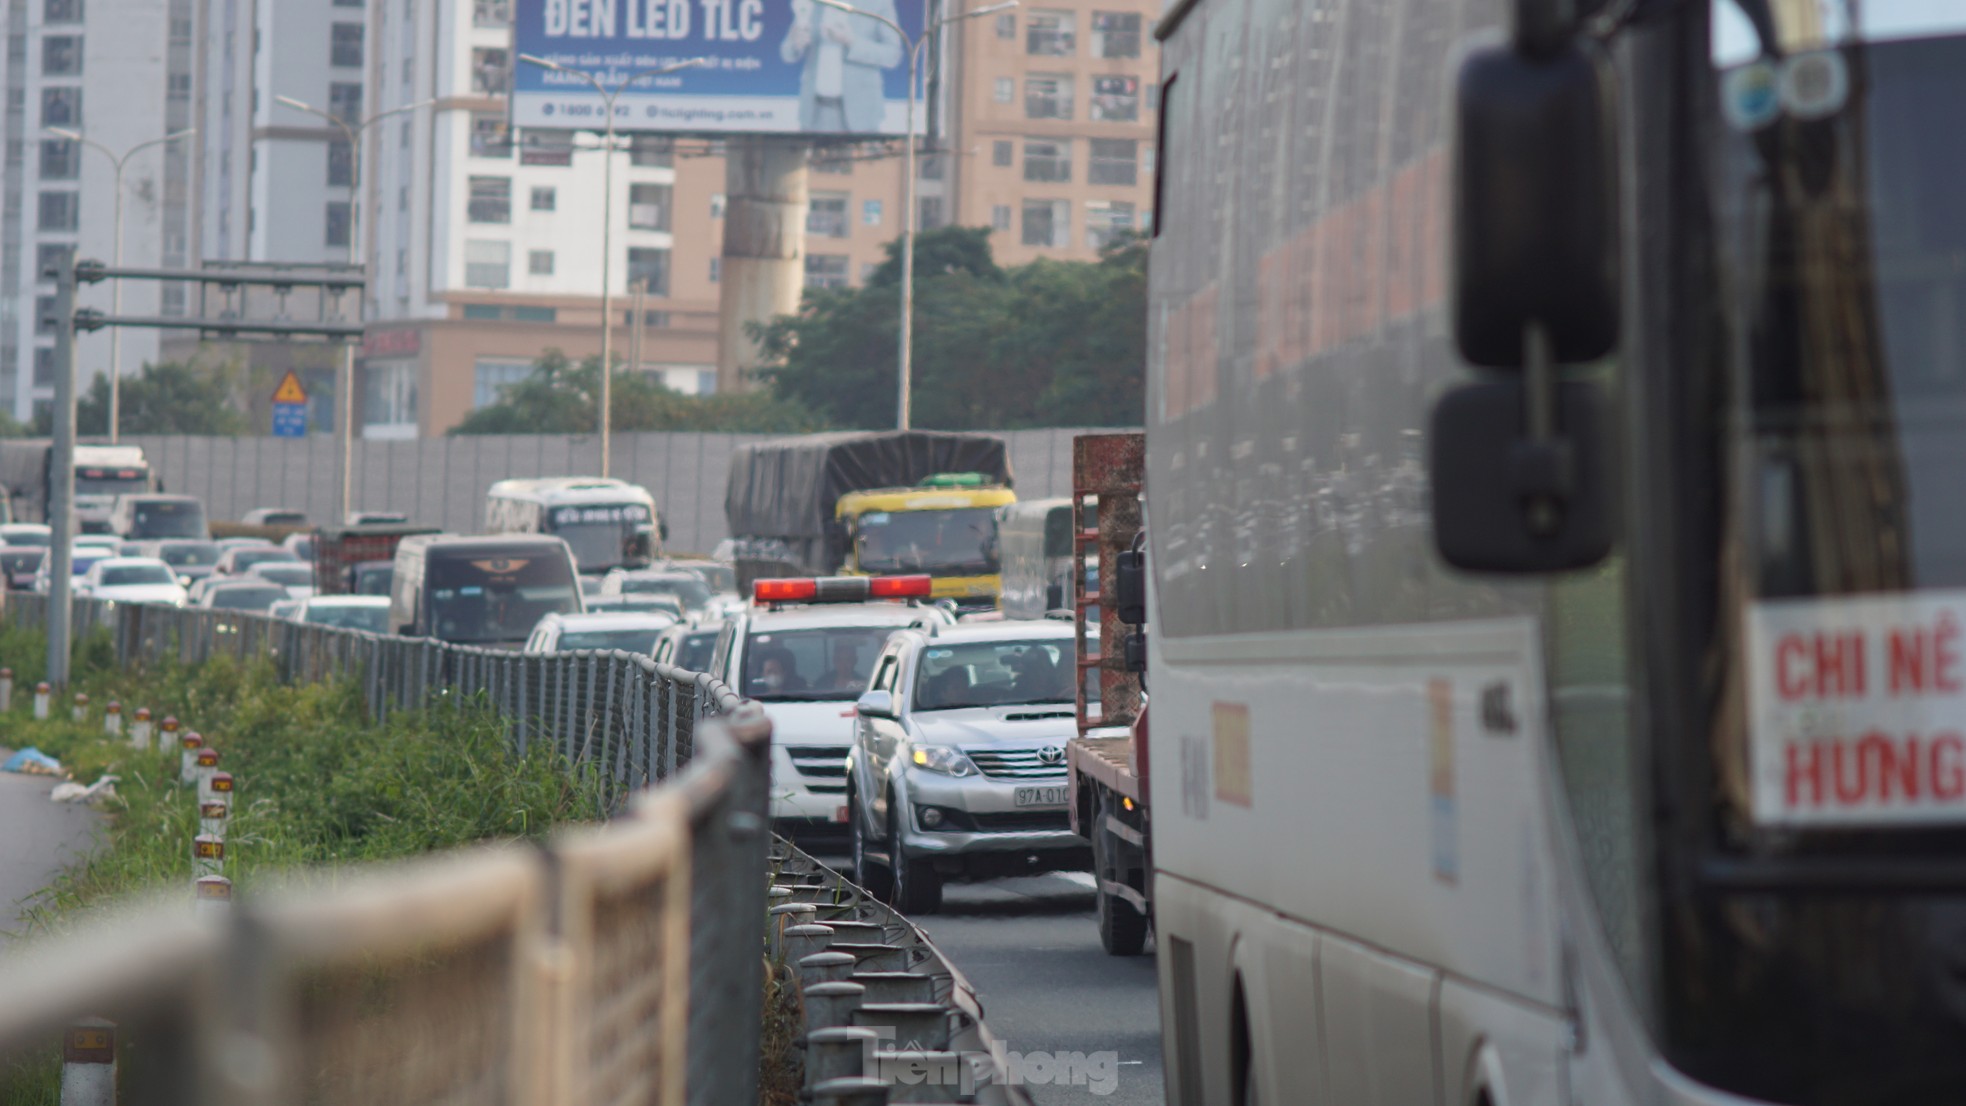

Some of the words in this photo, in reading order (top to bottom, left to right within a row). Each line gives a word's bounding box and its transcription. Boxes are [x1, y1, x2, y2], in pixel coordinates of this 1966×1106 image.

[626, 0, 691, 39] LED
[701, 0, 763, 41] TLC
[560, 104, 592, 116] 1800
[1776, 632, 1866, 702] CHI
